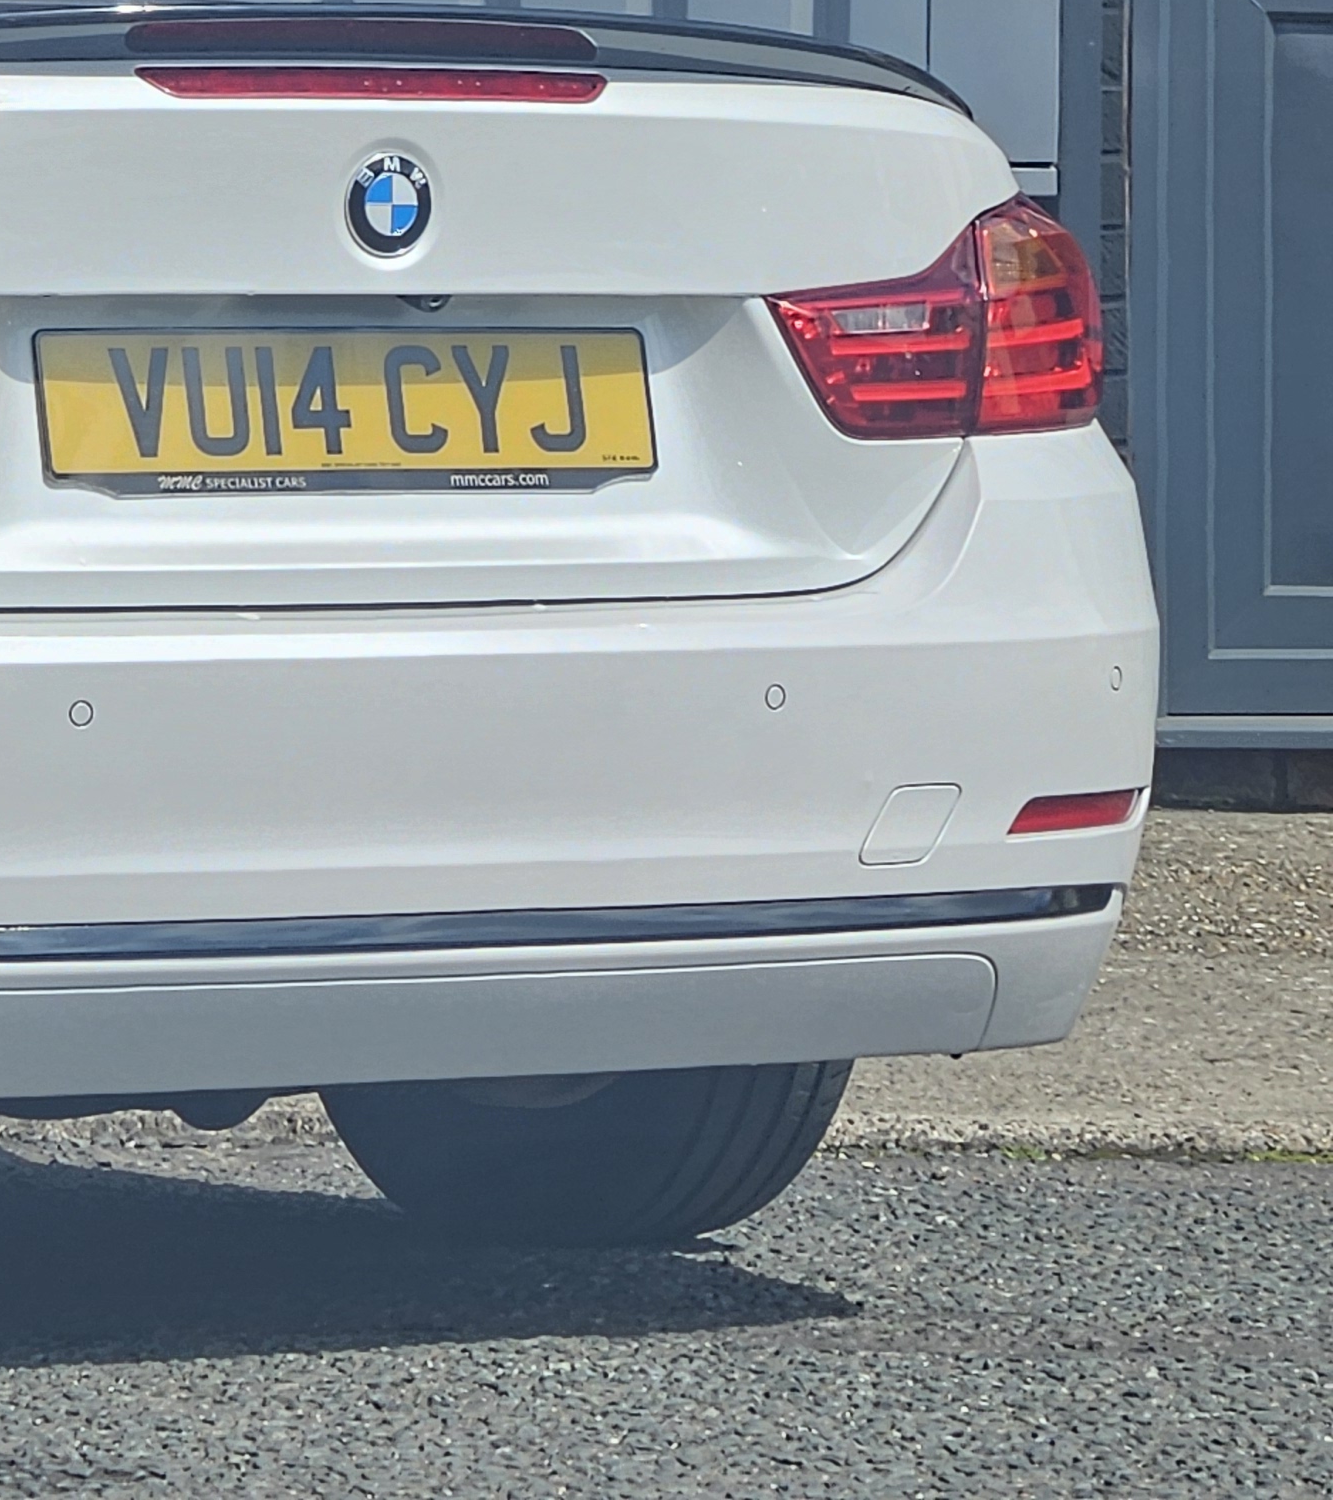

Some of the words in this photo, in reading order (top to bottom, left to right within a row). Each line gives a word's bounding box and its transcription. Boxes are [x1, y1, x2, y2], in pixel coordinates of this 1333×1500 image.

[356, 156, 427, 189] BMW
[107, 345, 352, 458] VU14
[383, 344, 587, 455] CYJ
[205, 477, 272, 489] SPECIALIST
[276, 476, 307, 489] CARS
[450, 472, 549, 487] mmccars.com
